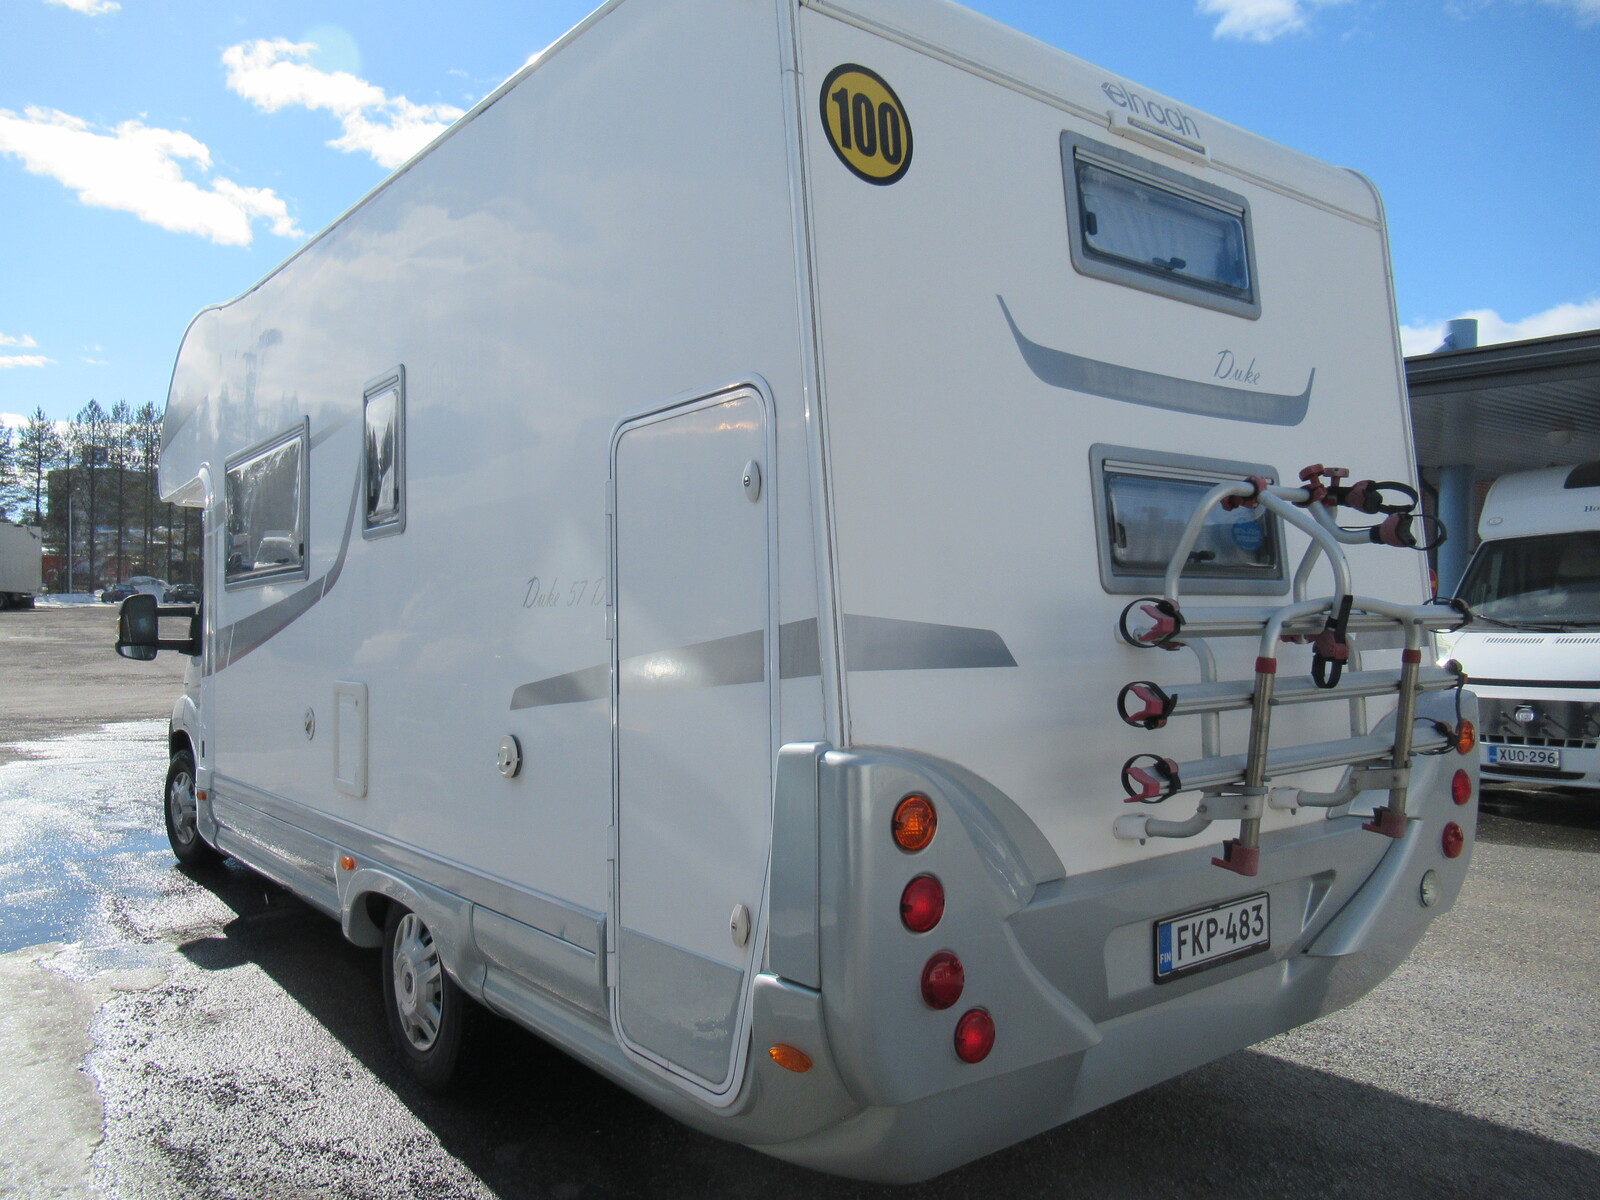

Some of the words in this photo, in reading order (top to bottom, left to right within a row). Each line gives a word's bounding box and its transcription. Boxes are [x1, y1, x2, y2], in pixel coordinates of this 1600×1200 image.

[831, 87, 902, 166] 100
[1213, 349, 1261, 385] Duke
[522, 575, 561, 609] Duke
[566, 579, 589, 608] 57
[1176, 903, 1264, 961] FKP-483
[1159, 951, 1171, 965] FIN
